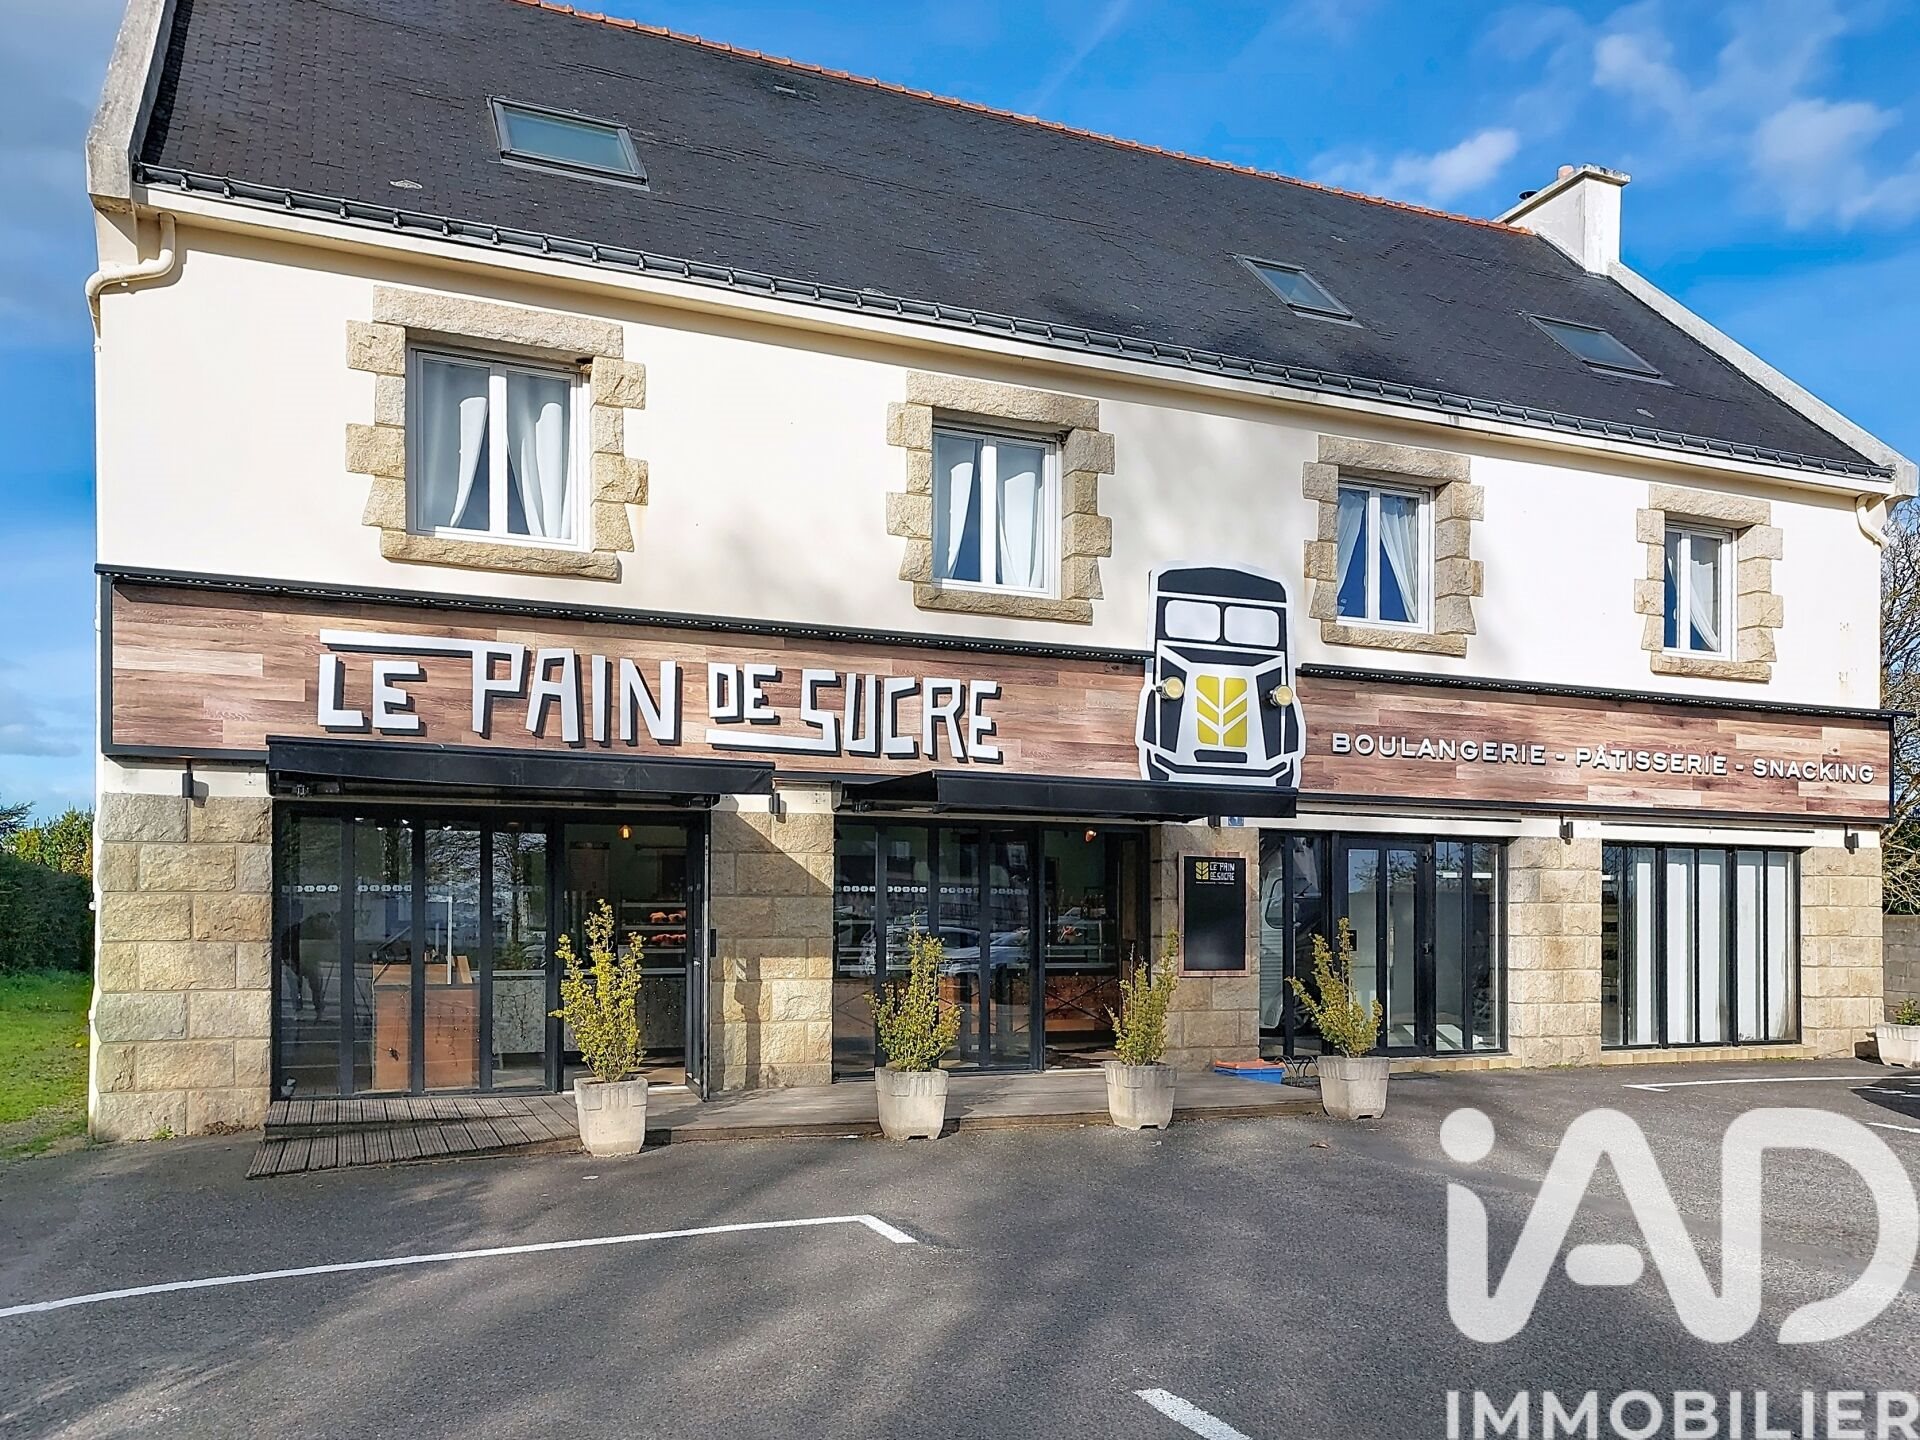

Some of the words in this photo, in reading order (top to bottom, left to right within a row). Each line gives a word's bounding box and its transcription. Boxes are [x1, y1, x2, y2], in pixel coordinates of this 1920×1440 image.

[317, 652, 425, 734] LE
[471, 640, 682, 744] PAIN
[707, 662, 779, 722] DE
[800, 668, 1001, 763] SUCRE
[1332, 732, 1546, 765] BOULANGERIE
[1575, 743, 1728, 776] PÂTISSERIE
[1752, 757, 1875, 784] SNACKING
[1210, 863, 1217, 871] LE
[1219, 862, 1235, 872] PAIN
[1216, 871, 1235, 881] SUCRE
